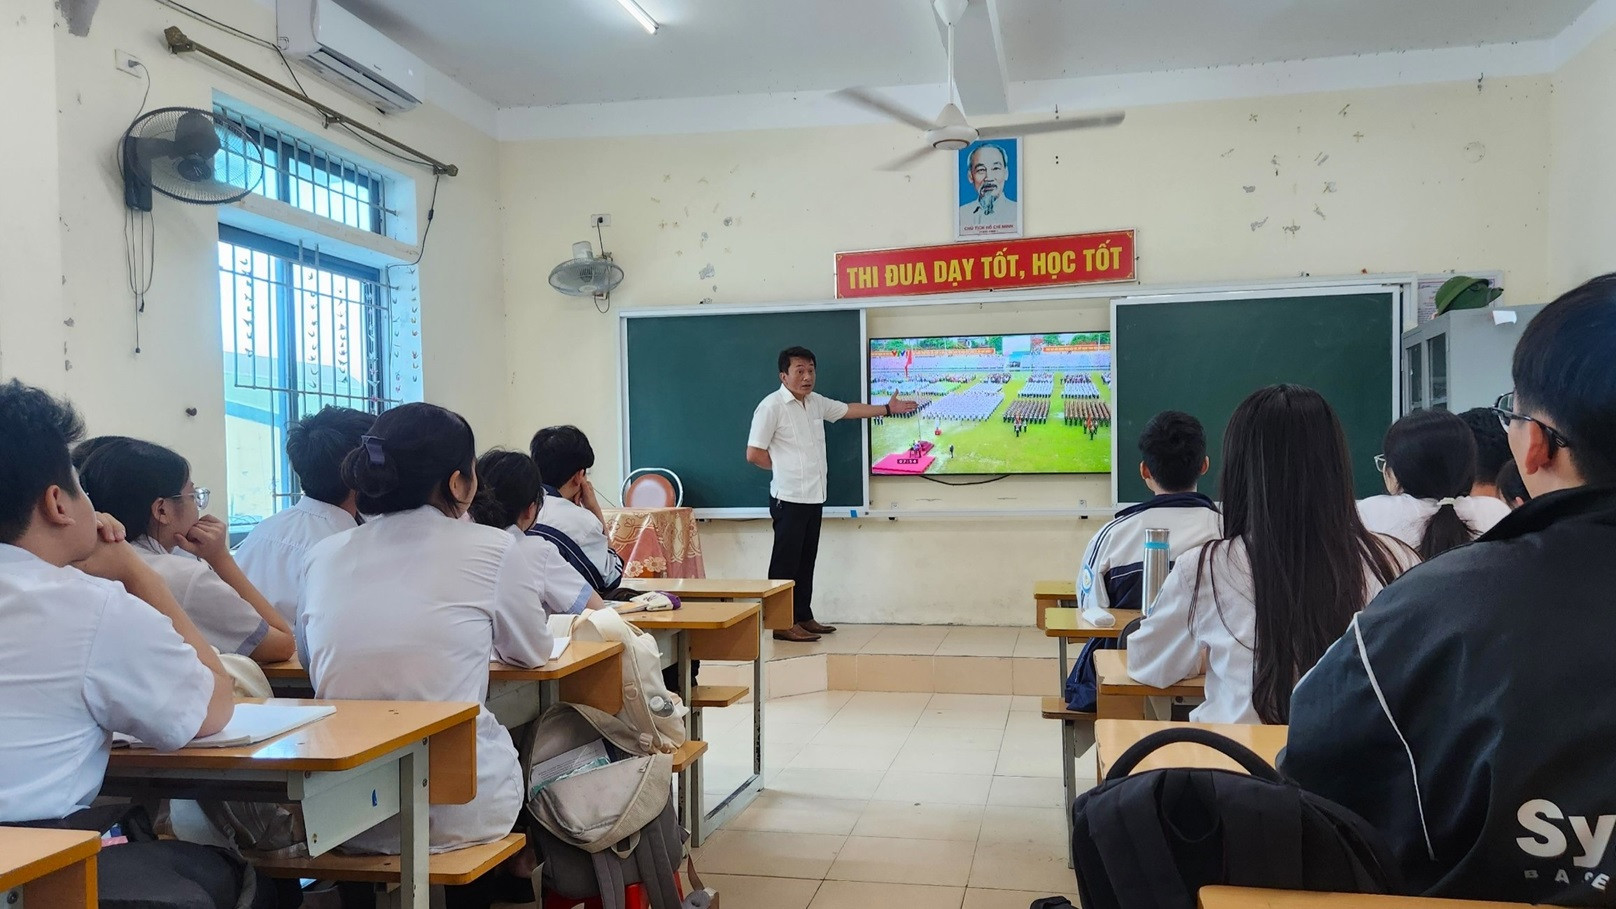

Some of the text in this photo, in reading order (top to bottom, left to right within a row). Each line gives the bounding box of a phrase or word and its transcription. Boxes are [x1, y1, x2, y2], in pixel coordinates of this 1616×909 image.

[846, 239, 1122, 289] THI ĐUA DẠY TỐT, HỌC TỐT
